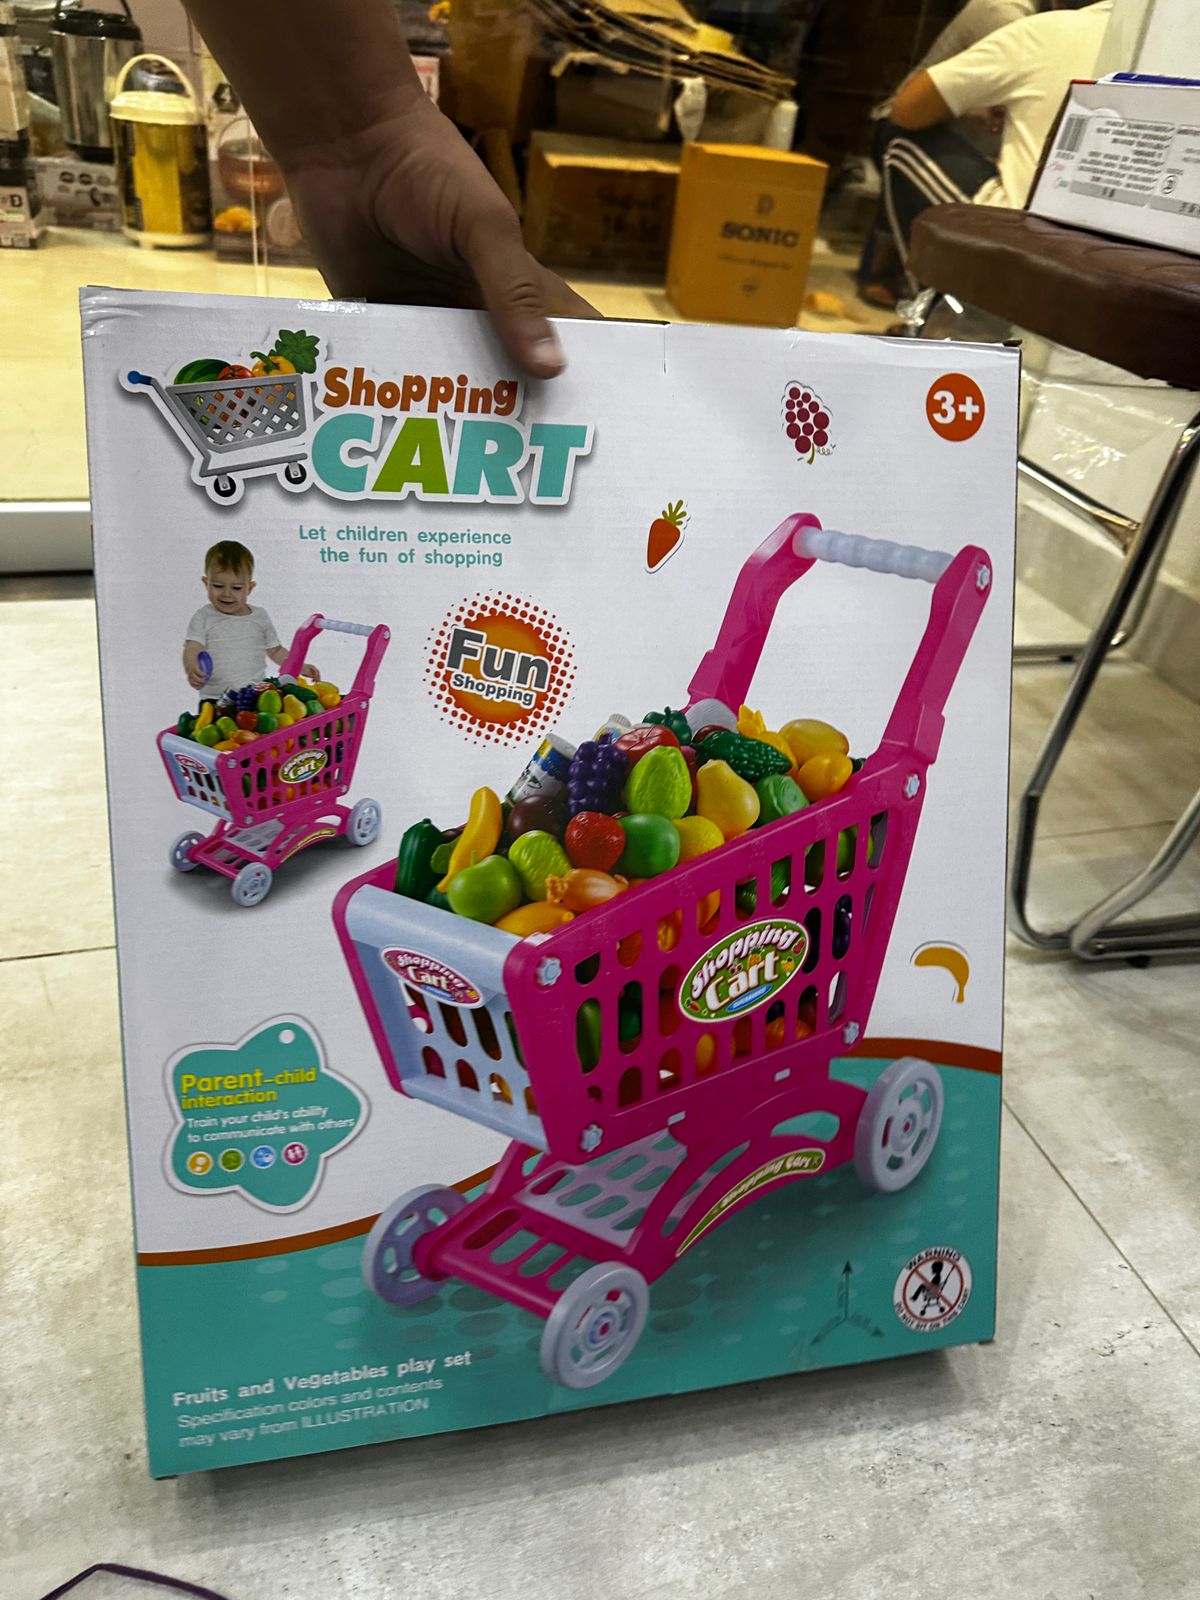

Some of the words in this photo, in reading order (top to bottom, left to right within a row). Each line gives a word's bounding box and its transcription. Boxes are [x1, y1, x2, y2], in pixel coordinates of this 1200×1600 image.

[722, 220, 799, 248] SONIC
[322, 366, 518, 417] Shopping
[932, 389, 980, 425] 3+
[311, 412, 588, 498] CART
[299, 525, 327, 542] Let
[336, 525, 408, 543] children
[417, 528, 512, 547] experience
[320, 546, 350, 564] the
[359, 547, 388, 564] fun
[397, 548, 416, 564] of
[424, 549, 503, 568] shopping
[447, 628, 550, 690] Fun
[452, 673, 535, 707] Shopping
[397, 954, 468, 988] Shopping
[406, 965, 451, 992] Cart
[691, 924, 801, 999] Shopping
[705, 950, 781, 1011] Cart
[181, 1089, 278, 1110] interaction
[187, 1116, 218, 1128] Train
[221, 1114, 249, 1128] your
[251, 1109, 289, 1122] child's
[292, 1105, 328, 1118] ability
[187, 1132, 200, 1143] to
[203, 1125, 286, 1142] communicate
[288, 1121, 315, 1134] with
[317, 1117, 356, 1131] others
[906, 1247, 962, 1270] WARNING
[172, 1387, 229, 1407] Fruits
[238, 1378, 275, 1398] and
[283, 1364, 389, 1389] Vegetables
[397, 1357, 437, 1378] play
[443, 1351, 473, 1368] set
[178, 1402, 284, 1429] Specification
[287, 1395, 337, 1412] colors
[340, 1387, 373, 1404] and
[376, 1378, 444, 1398] contents
[178, 1433, 215, 1448] may
[219, 1426, 256, 1441] vary
[259, 1420, 298, 1435] from
[301, 1397, 430, 1429] ILLUSTRATION
